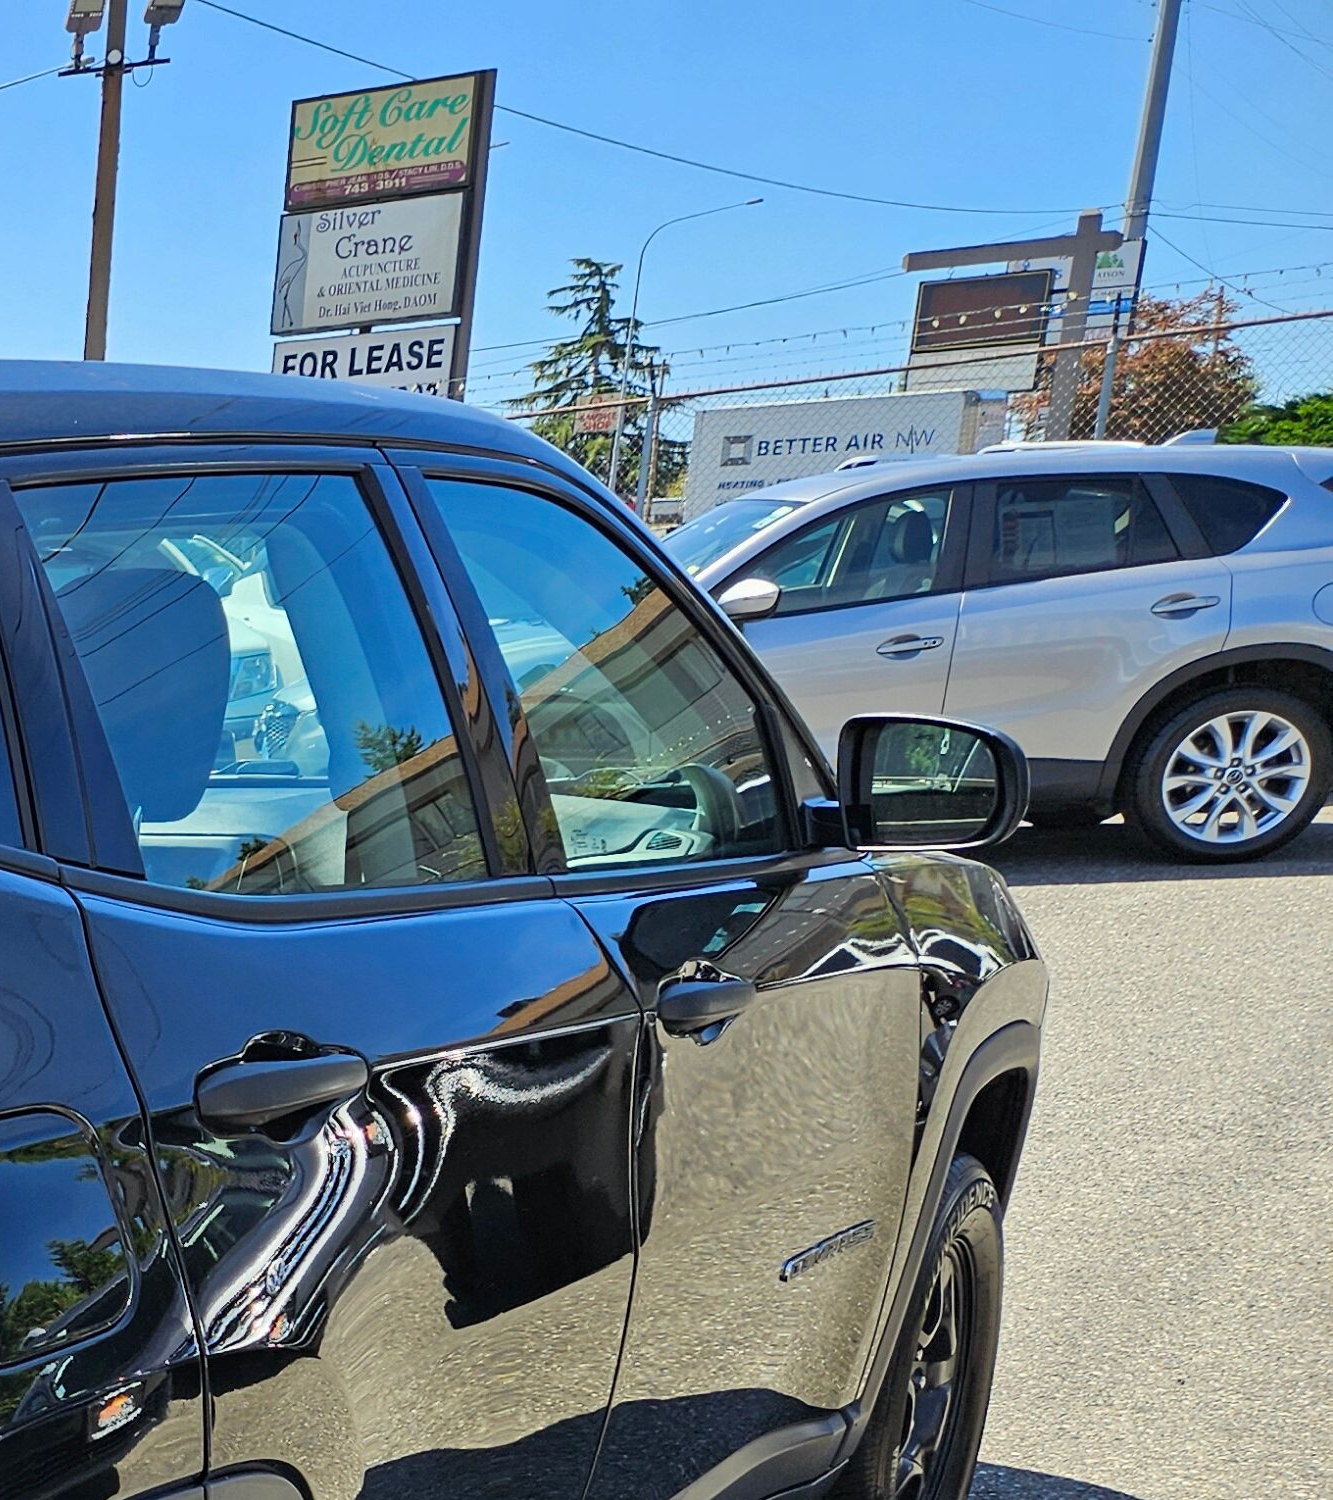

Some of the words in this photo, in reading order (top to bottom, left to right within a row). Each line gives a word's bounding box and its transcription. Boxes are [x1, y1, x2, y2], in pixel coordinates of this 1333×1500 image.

[294, 94, 374, 149] Soft
[379, 89, 470, 128] Care
[330, 117, 470, 172] Dental
[316, 209, 382, 233] Silver
[335, 234, 413, 260] Crane
[341, 257, 421, 280] ACUPUNCTURE
[317, 287, 325, 298] &
[328, 280, 383, 297] ORIENTAL
[385, 272, 441, 290] MEDICINE
[318, 305, 332, 319] Dr.
[334, 303, 351, 317] Hai
[353, 300, 372, 314] Viet
[403, 292, 438, 310] DAOM
[282, 350, 339, 379] FOR
[348, 338, 446, 377] LEASE
[756, 435, 838, 457] BETTER
[845, 432, 885, 451] AIR
[717, 478, 766, 490] HEATING
